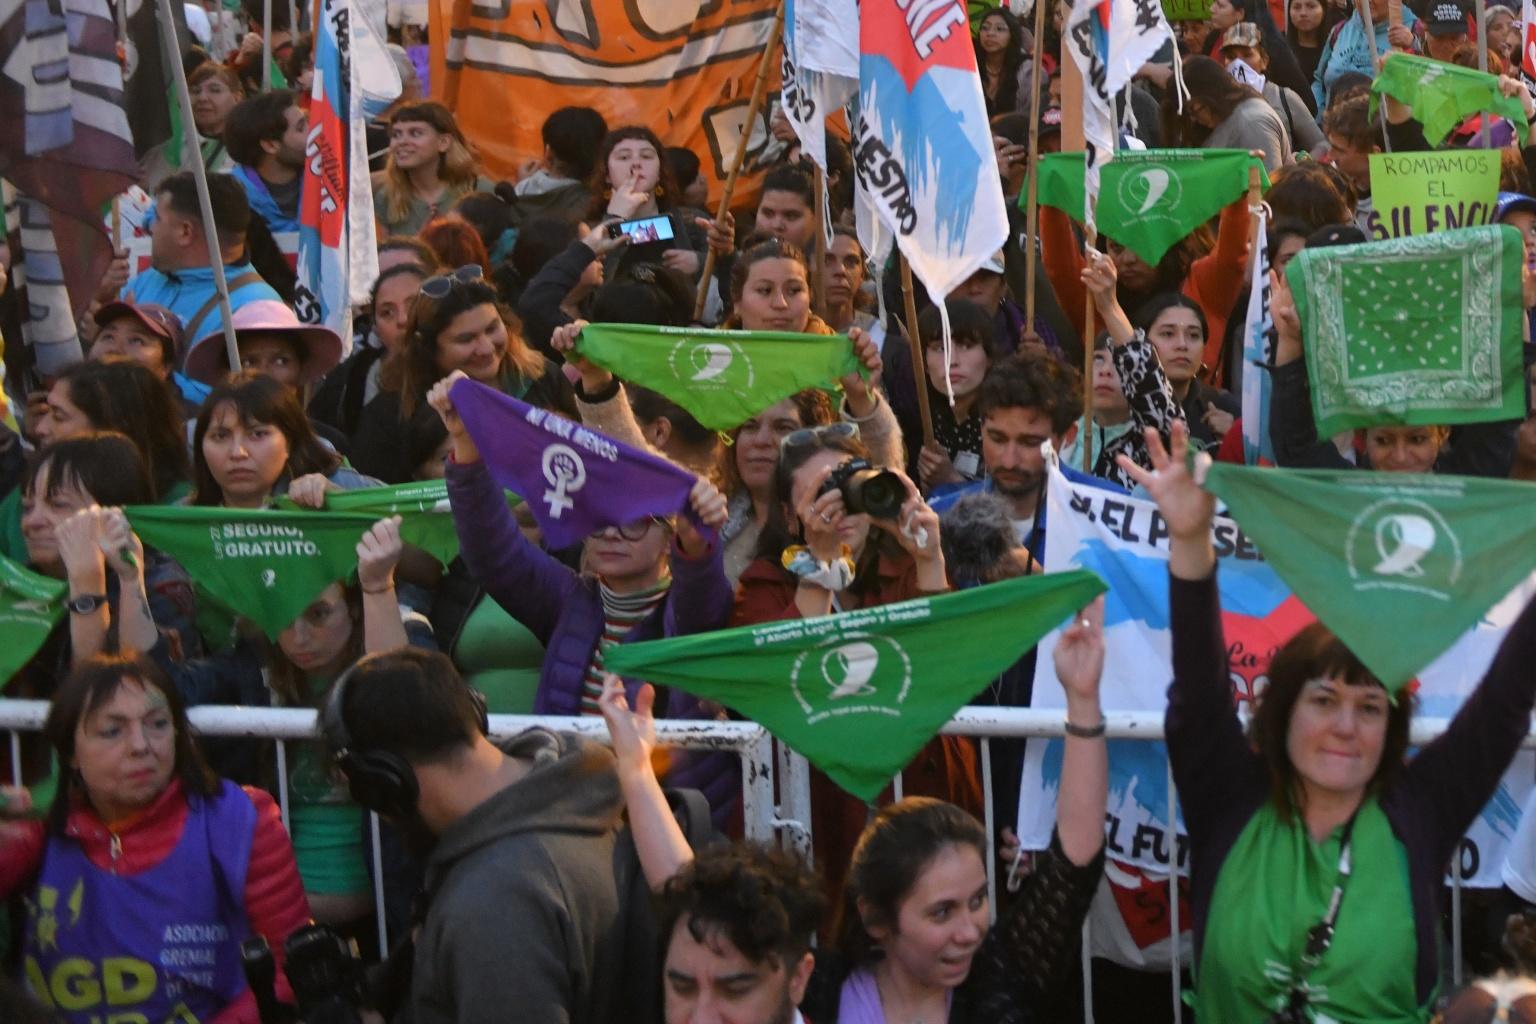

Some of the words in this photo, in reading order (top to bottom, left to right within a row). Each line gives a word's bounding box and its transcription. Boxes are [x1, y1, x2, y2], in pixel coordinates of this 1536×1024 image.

[1383, 155, 1489, 176] ROMPAMOS
[1427, 180, 1455, 198] EL
[543, 413, 575, 441] UNA
[571, 426, 619, 463] MENOS
[1101, 498, 1140, 544] EL
[839, 615, 877, 630] Seguro
[887, 607, 932, 622] Gratuito
[1228, 641, 1258, 668] La
